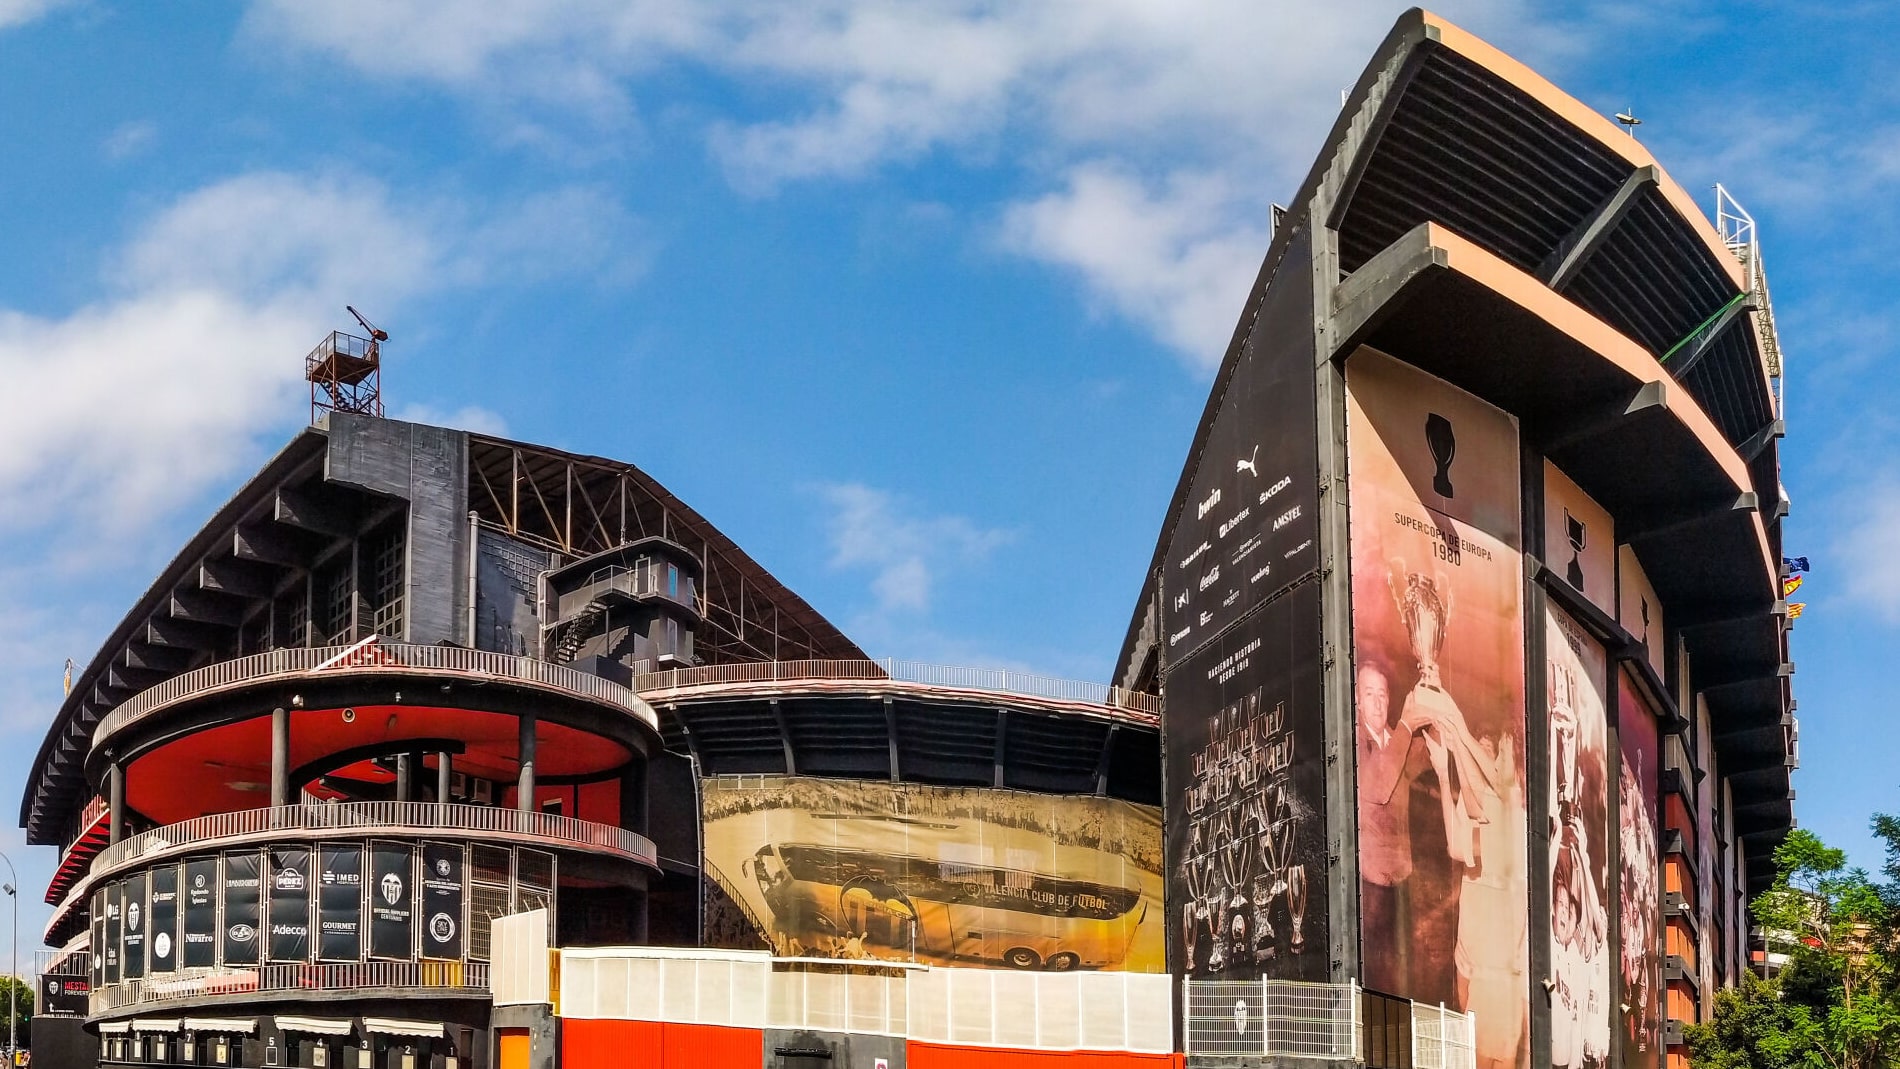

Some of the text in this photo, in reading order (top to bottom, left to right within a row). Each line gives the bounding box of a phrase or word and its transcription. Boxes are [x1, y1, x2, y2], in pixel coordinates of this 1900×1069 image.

[1259, 475, 1291, 505] ŠKODA
[1198, 488, 1221, 520] bwin
[1225, 506, 1249, 534] Libertex
[1272, 504, 1301, 532] AMSTEL
[1394, 512, 1493, 562] SUPERCOPA DE EUROPA
[1432, 541, 1461, 567] 1980
[1199, 564, 1220, 592] Coca-Cola
[1208, 637, 1261, 680] HACIENDO HISTORIA
[1219, 666, 1236, 685] DESDE
[336, 873, 359, 881] IMED
[984, 884, 1029, 900] VALENCIA
[1031, 891, 1055, 904] CLUB
[1057, 895, 1070, 907] DE
[112, 904, 119, 916] LG
[272, 924, 307, 936] Adecco
[322, 921, 357, 929] GOURMET
[186, 934, 213, 943] Navarro
[186, 1033, 192, 1042] 7
[219, 1035, 224, 1044] 6
[268, 1037, 275, 1046] 5
[316, 1038, 323, 1047] 4
[361, 1040, 368, 1049] 3
[404, 1045, 411, 1055] 2
[450, 1047, 455, 1056] 1
